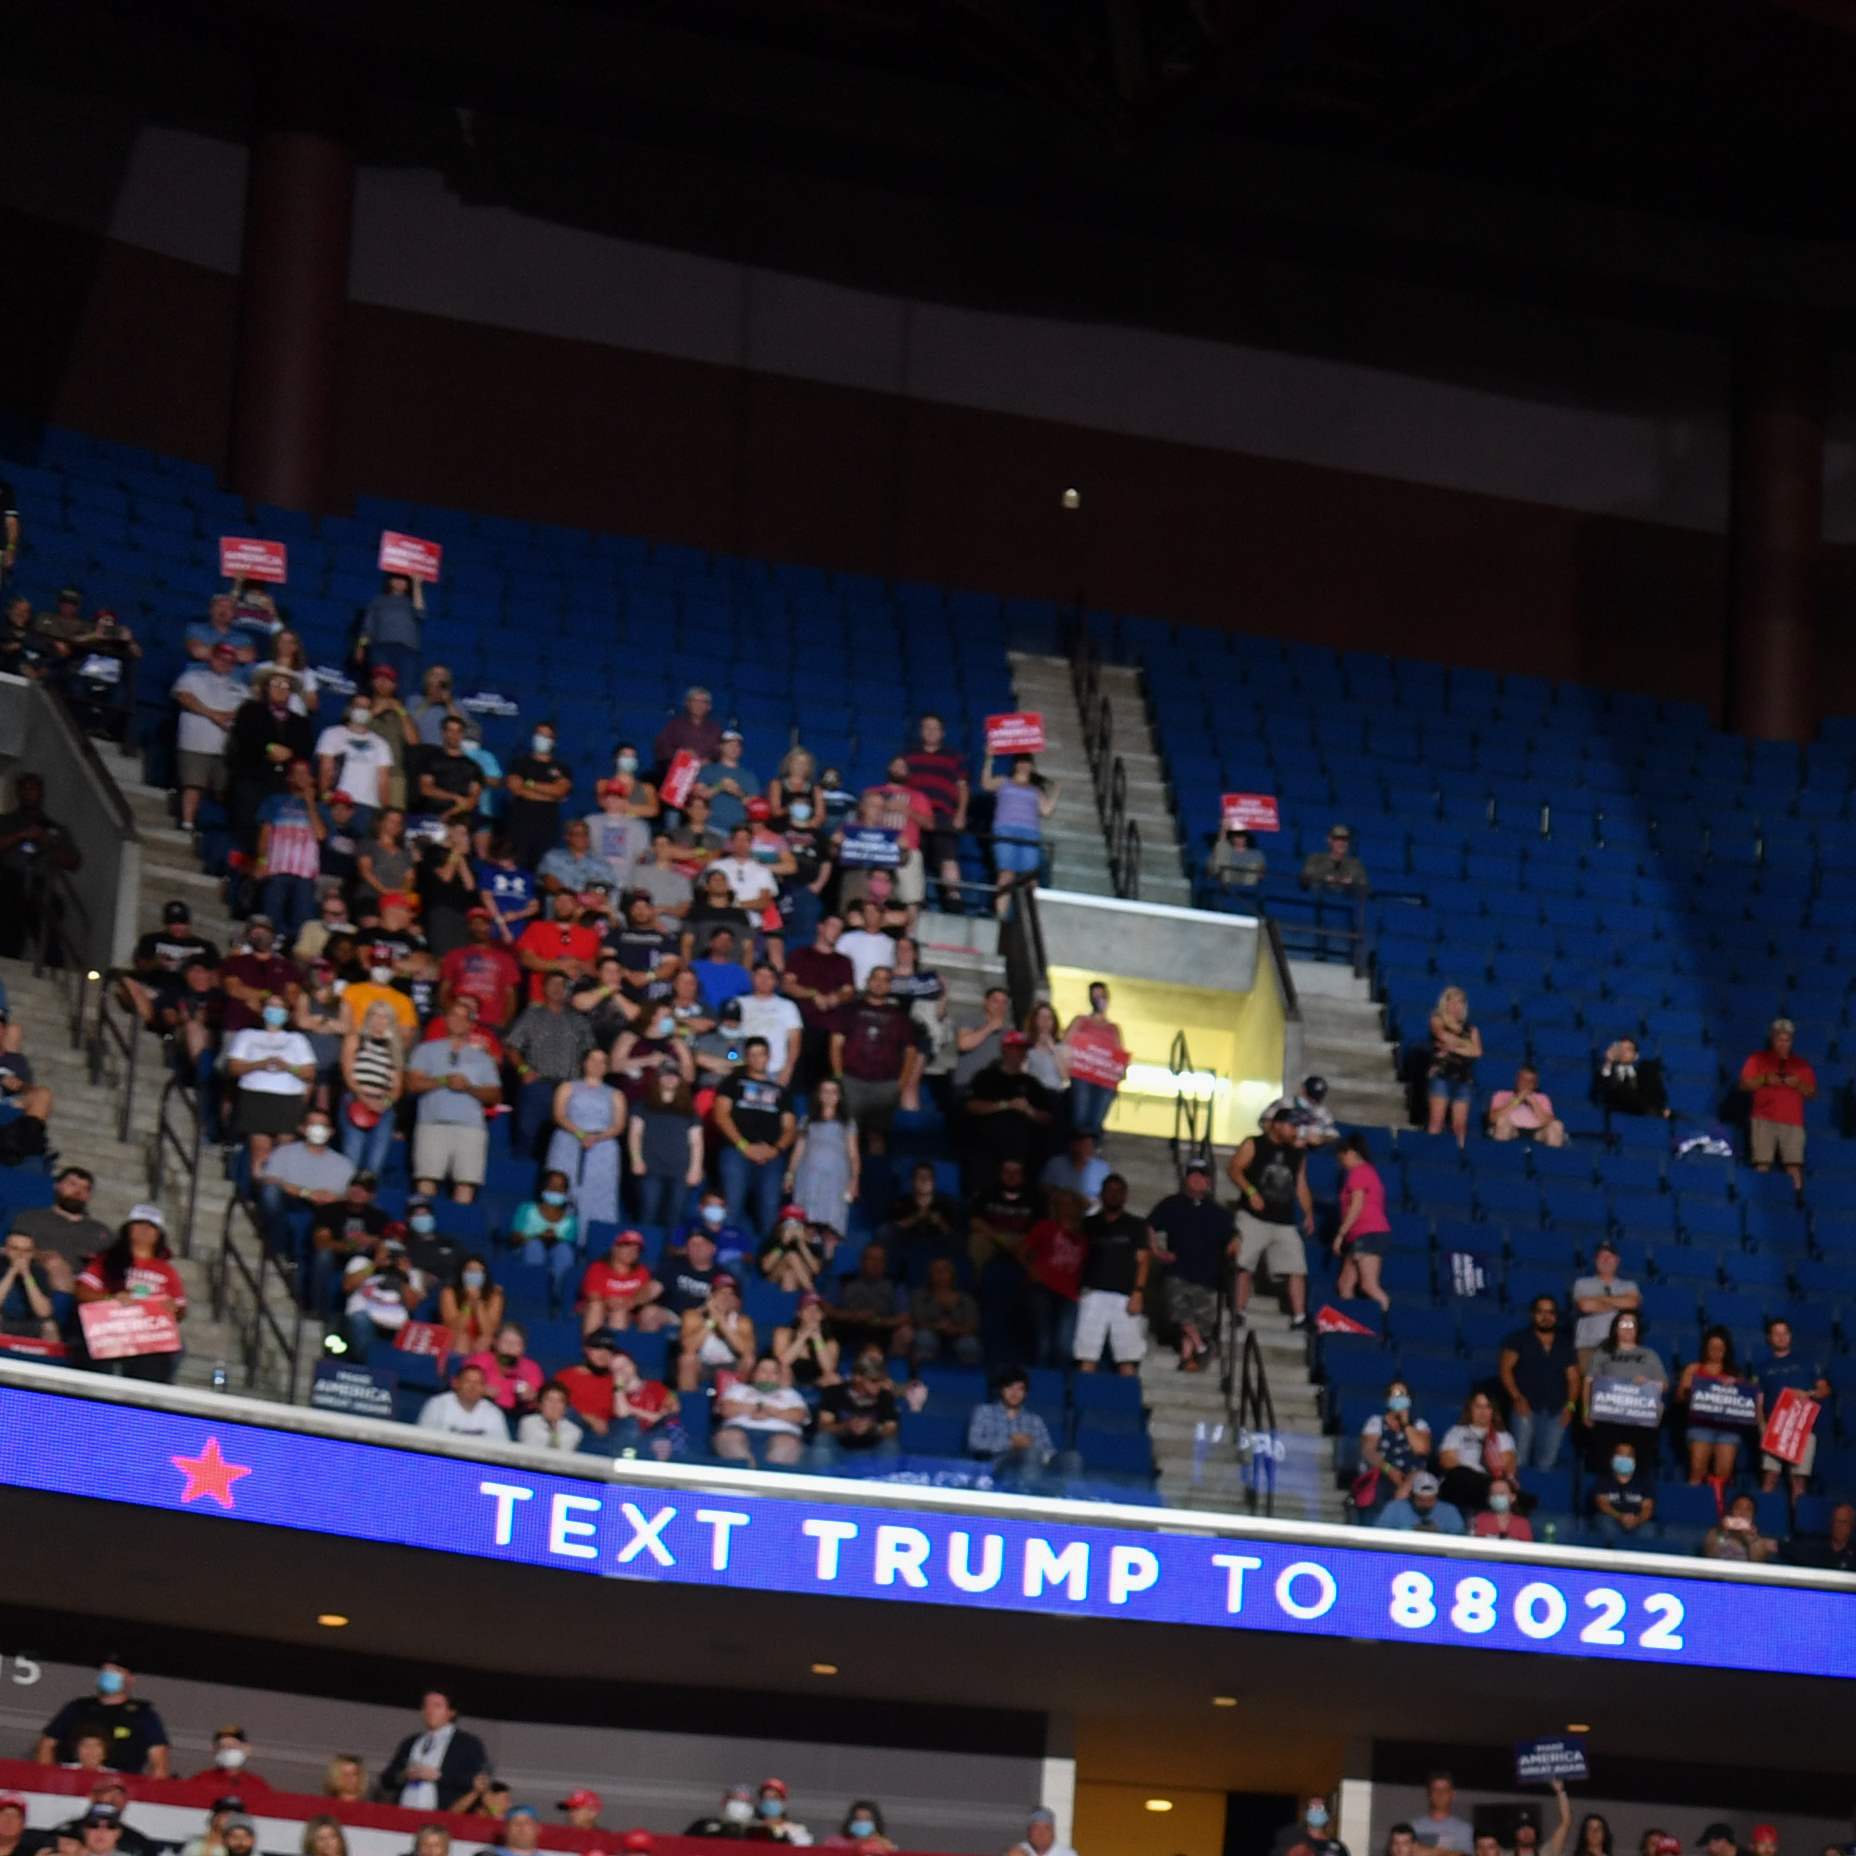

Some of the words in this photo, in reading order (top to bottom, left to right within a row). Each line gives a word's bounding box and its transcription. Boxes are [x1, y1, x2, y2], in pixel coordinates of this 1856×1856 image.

[1595, 1391, 1658, 1409] AMERICA
[1692, 1389, 1756, 1409] AMERICA
[480, 1480, 748, 1572] TEXT
[802, 1518, 1159, 1605] TRUMP
[1210, 1554, 1336, 1620] TO
[1389, 1570, 1684, 1650] 88022
[1519, 1751, 1585, 1767] AMERICA
